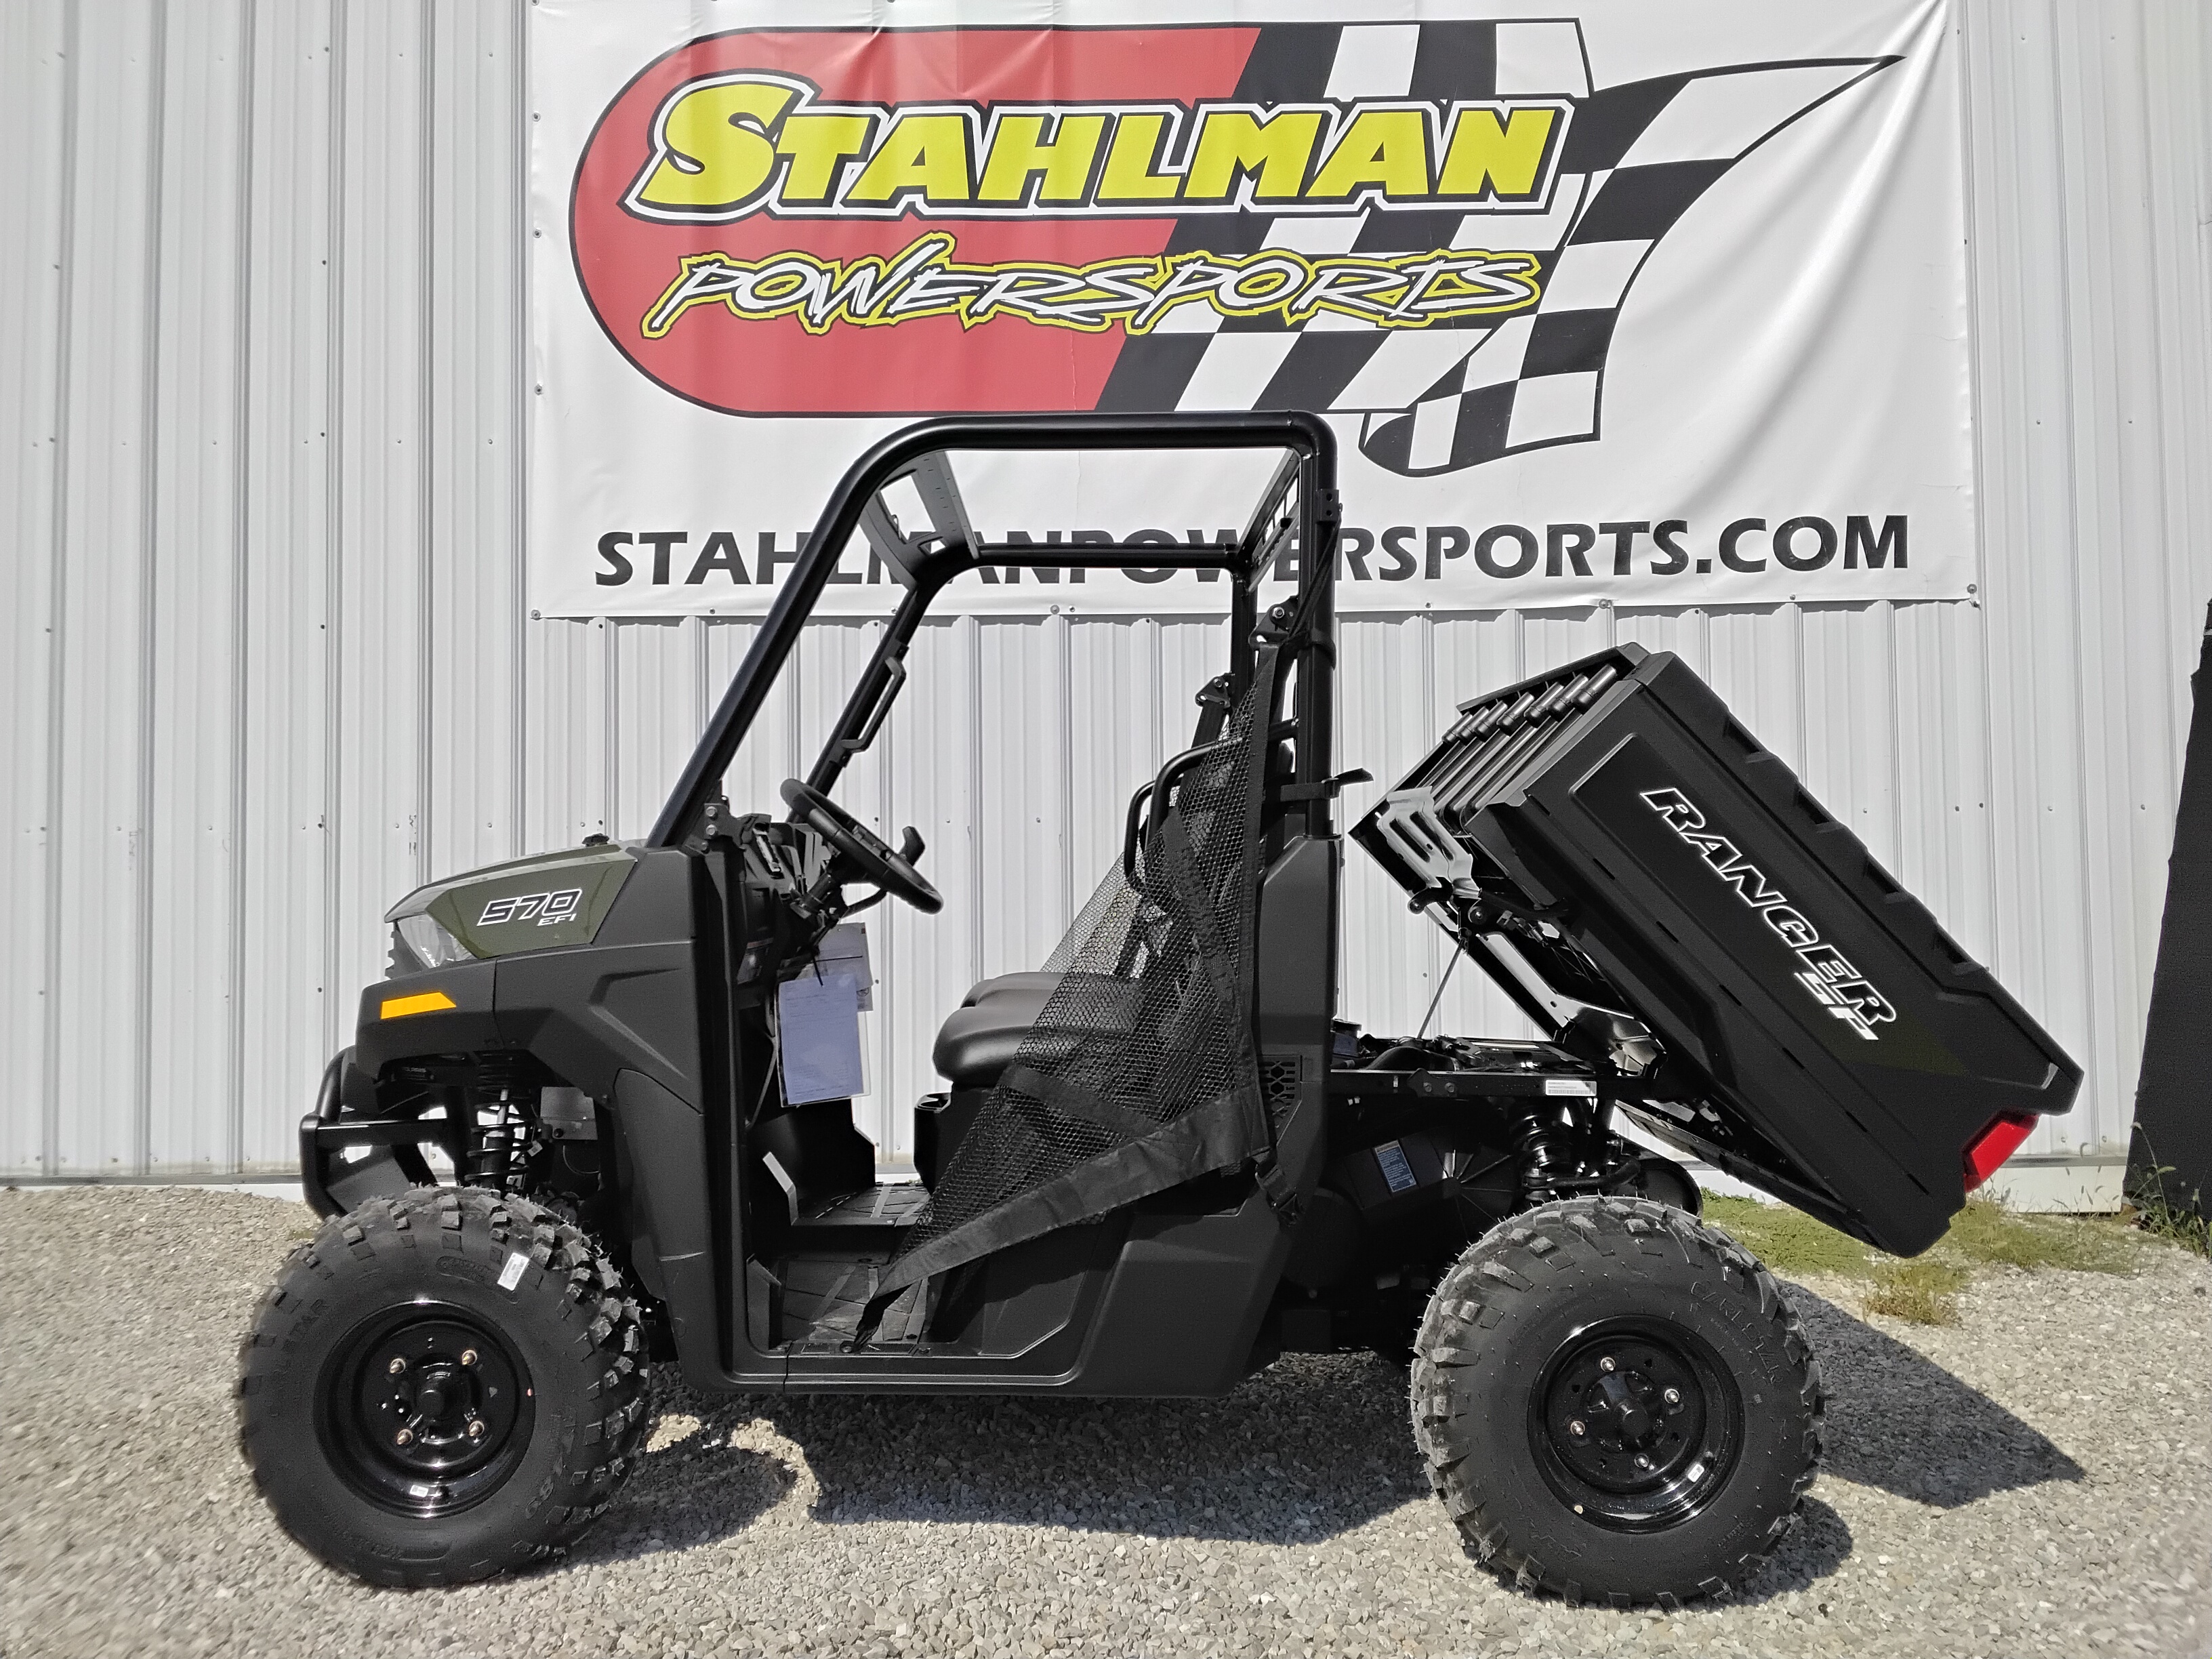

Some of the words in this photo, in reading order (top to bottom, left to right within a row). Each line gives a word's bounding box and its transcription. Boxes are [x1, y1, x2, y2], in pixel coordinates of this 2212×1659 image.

[630, 76, 1562, 214] STAHLMAN
[645, 232, 1539, 335] POWERSPORTS
[594, 514, 1908, 586] STAHNOERSPORTS.COM
[476, 888, 582, 926] 570
[537, 913, 576, 926] EFI
[1639, 787, 1896, 1025] RANGER
[1794, 972, 1879, 1040] SP
